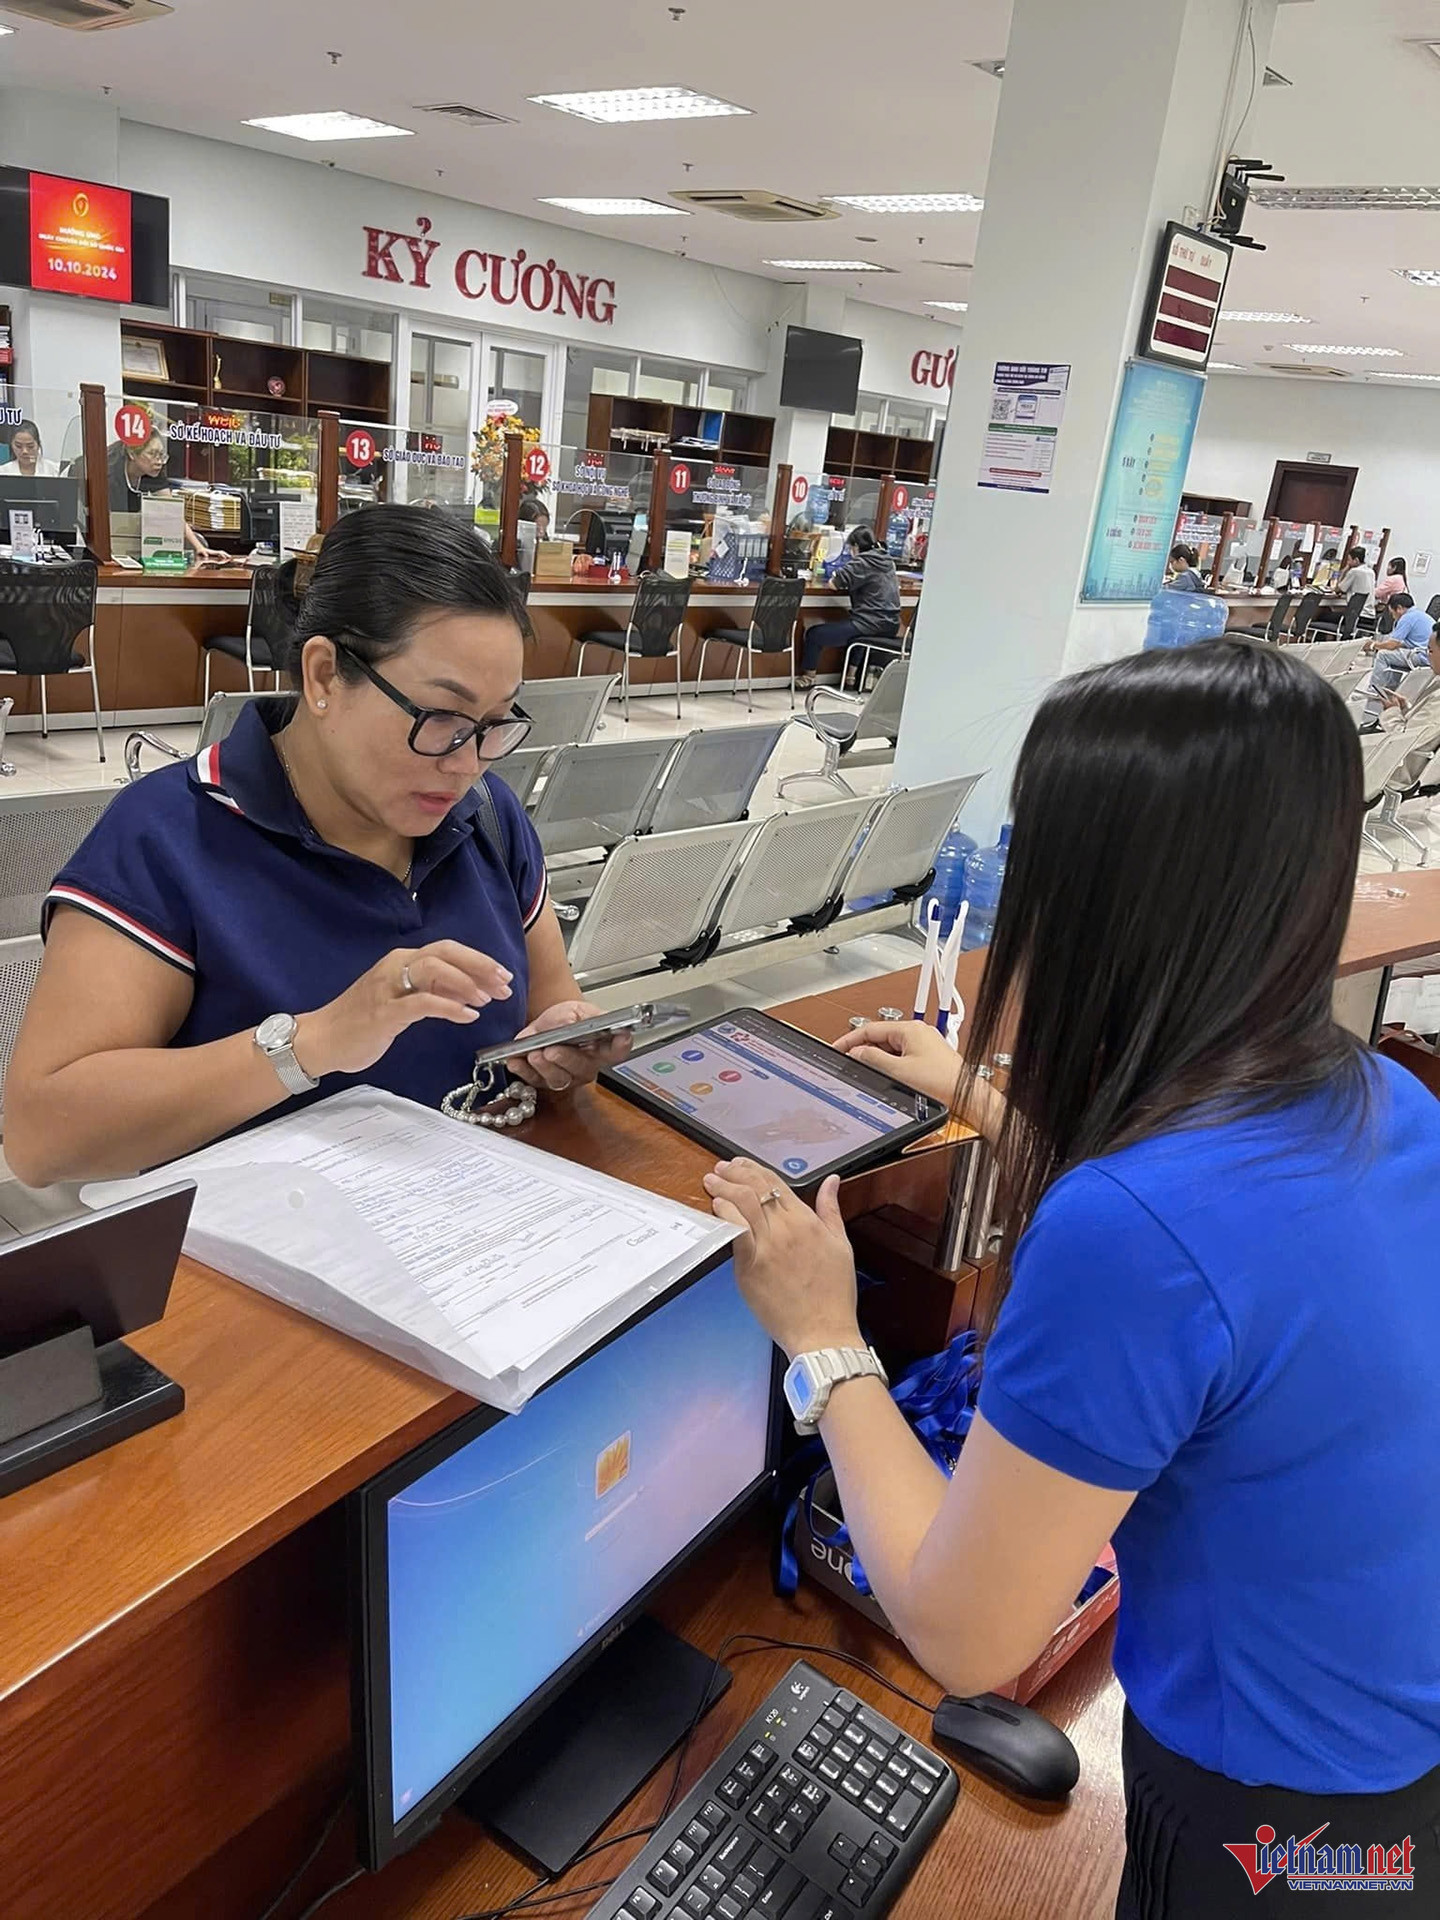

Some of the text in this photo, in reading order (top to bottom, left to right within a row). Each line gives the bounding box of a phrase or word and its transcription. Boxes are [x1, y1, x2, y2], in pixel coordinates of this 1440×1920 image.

[48, 257, 118, 280] 10.10.2024
[362, 217, 617, 324] KỶ CƯƠNG
[120, 413, 145, 439] 14
[170, 420, 185, 440] SỞ
[200, 427, 233, 447] HOẠCH
[350, 437, 371, 460] 13
[529, 455, 545, 475] 12
[675, 470, 687, 488] 11
[795, 480, 806, 498] 10
[897, 491, 904, 507] 9
